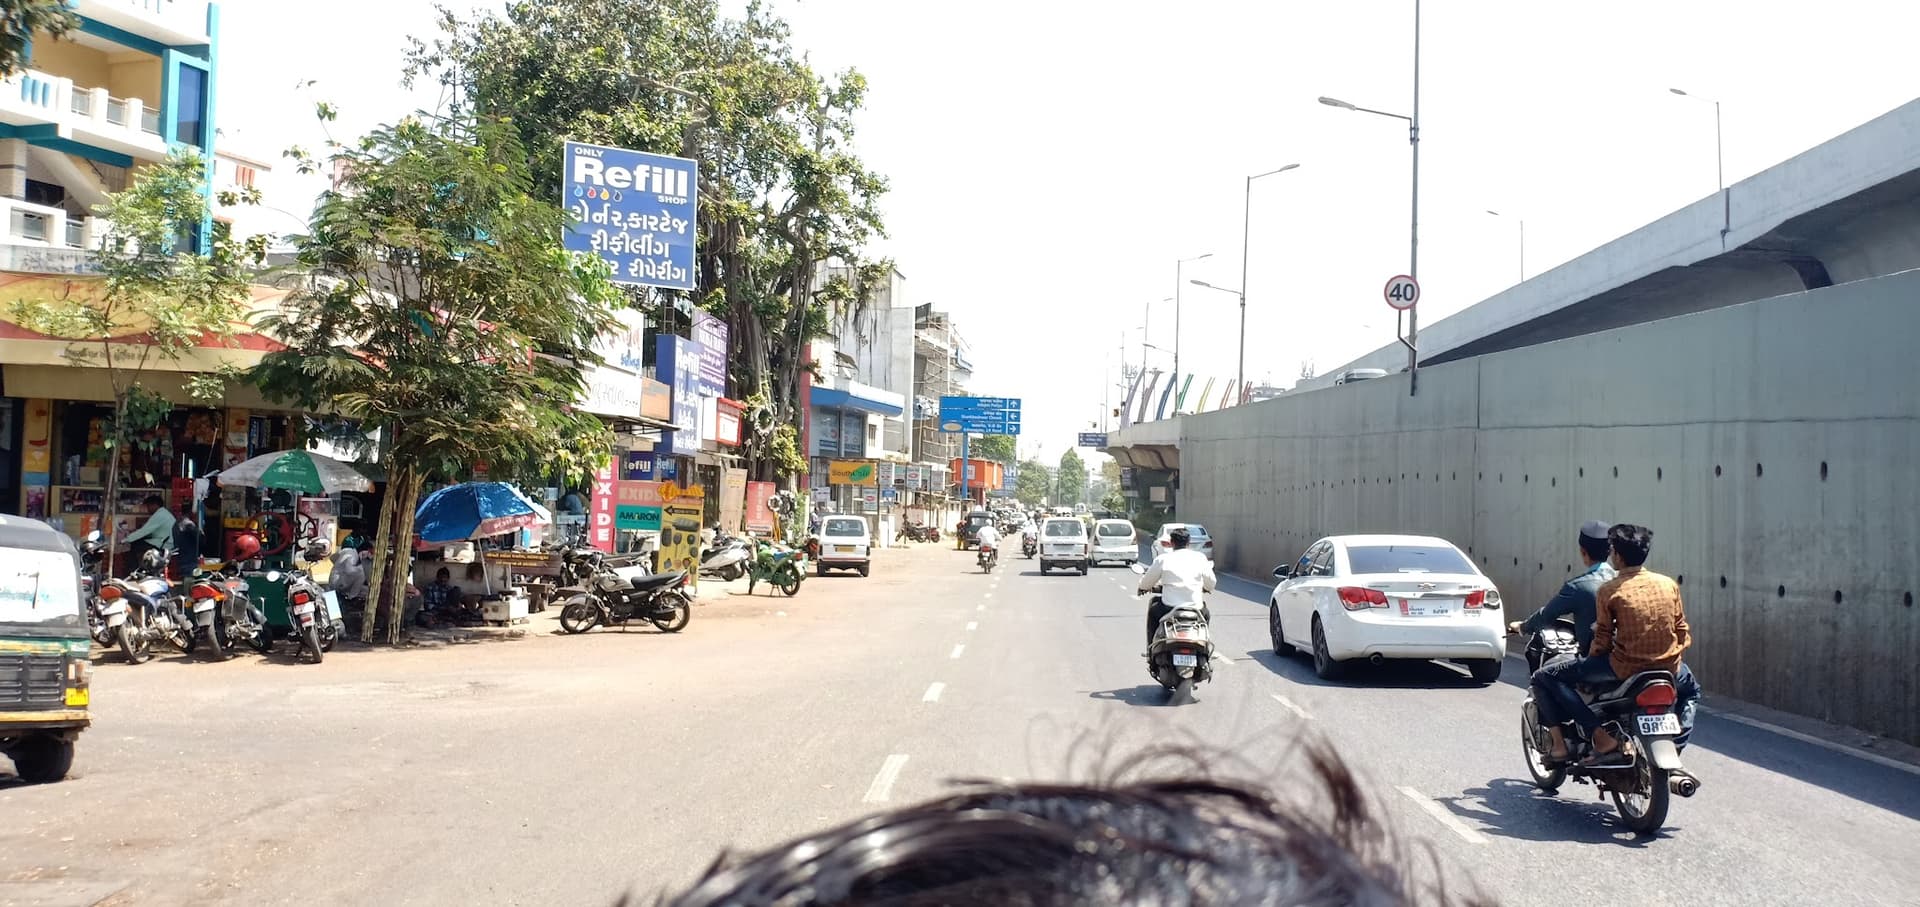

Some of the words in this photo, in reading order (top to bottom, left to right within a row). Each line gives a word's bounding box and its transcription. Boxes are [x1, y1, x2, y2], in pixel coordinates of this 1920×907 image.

[574, 147, 604, 158] ONLY
[574, 155, 688, 197] Refill
[658, 195, 688, 206] SHOP
[1389, 283, 1415, 301] 40
[596, 464, 612, 542] EXIDE
[618, 510, 660, 521] AMARON
